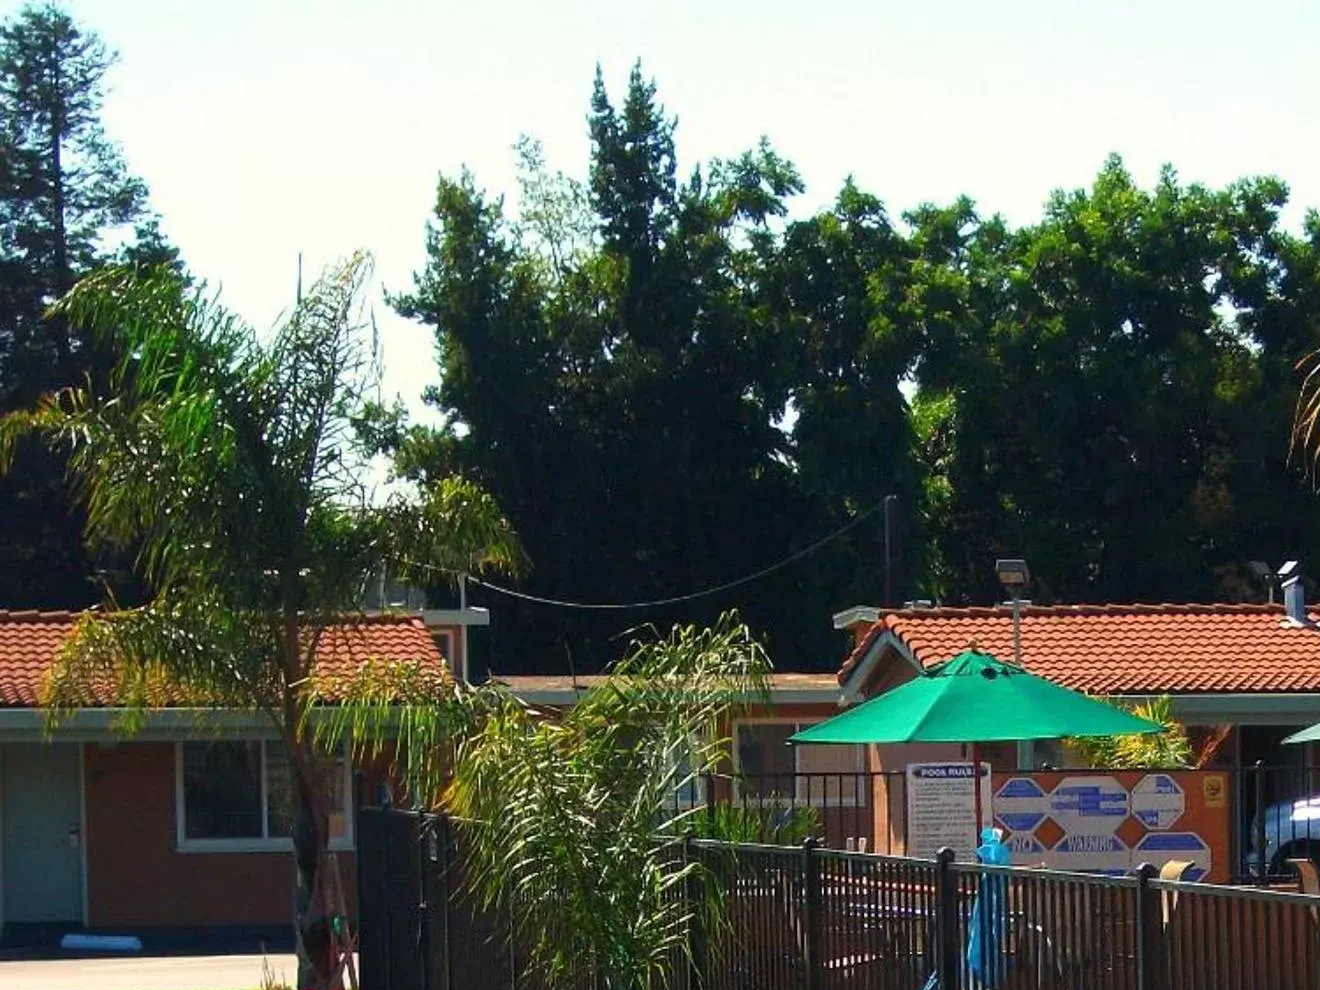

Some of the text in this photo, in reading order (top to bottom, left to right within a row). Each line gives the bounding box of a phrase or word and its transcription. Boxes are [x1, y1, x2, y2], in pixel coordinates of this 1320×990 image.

[921, 768, 946, 777] POOL
[1012, 835, 1033, 852] NO
[1067, 834, 1113, 852] WARNING
